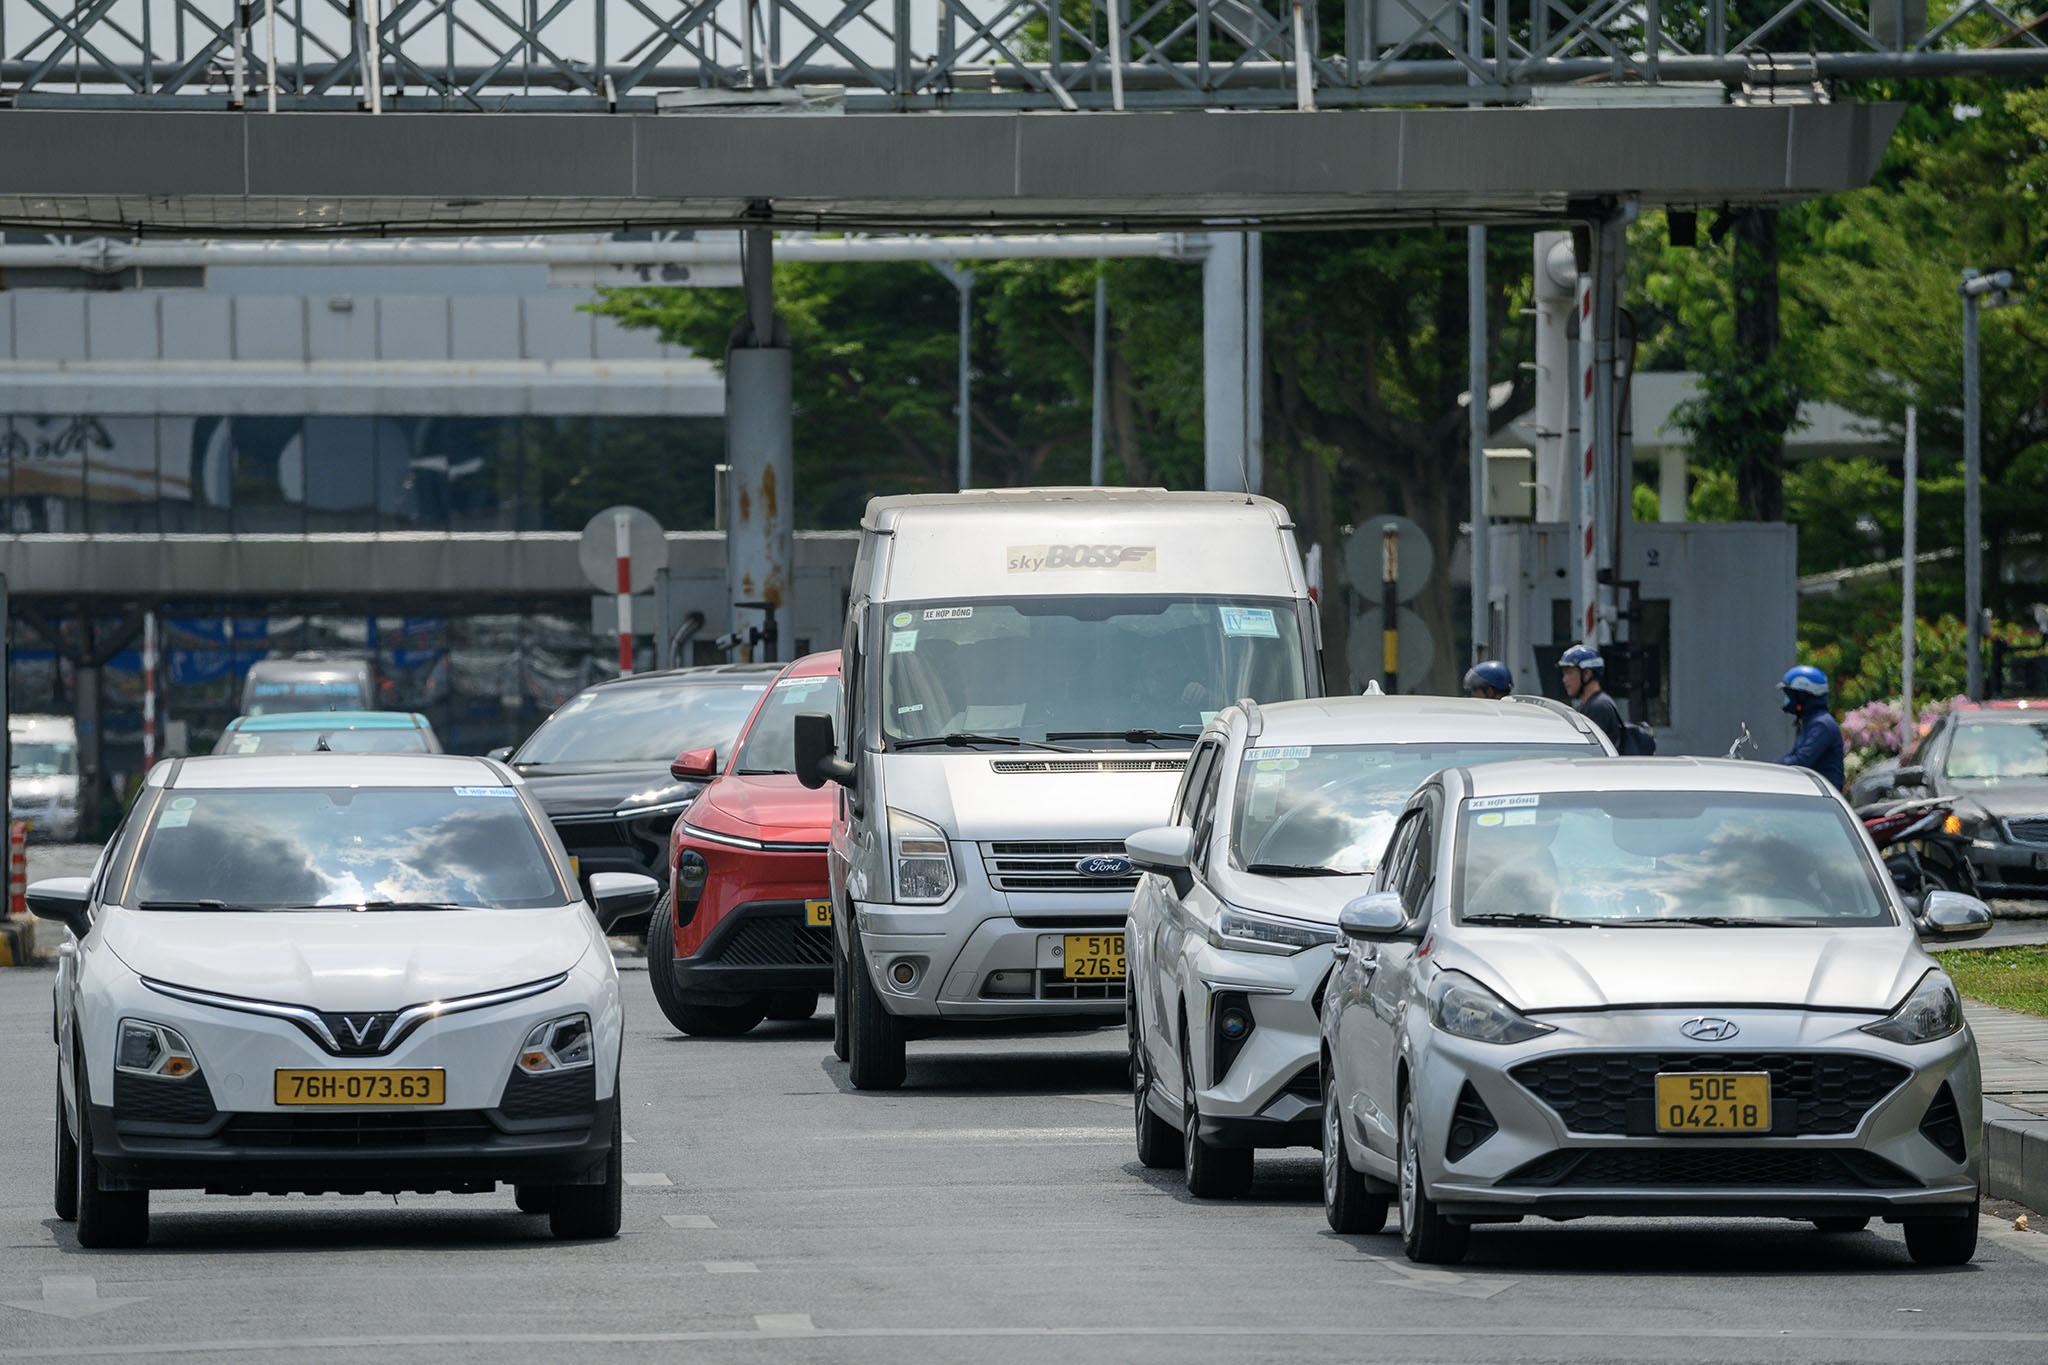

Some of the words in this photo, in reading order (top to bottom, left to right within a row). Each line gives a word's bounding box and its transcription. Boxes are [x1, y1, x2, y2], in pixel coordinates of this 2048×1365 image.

[925, 610, 934, 619] XE
[1089, 858, 1122, 872] Ford
[1089, 937, 1125, 955] 51B
[1074, 957, 1126, 975] 276.9
[291, 1076, 430, 1098] 76H-073.63
[1689, 1078, 1737, 1100] 50E
[1670, 1105, 1758, 1127] 042.18
